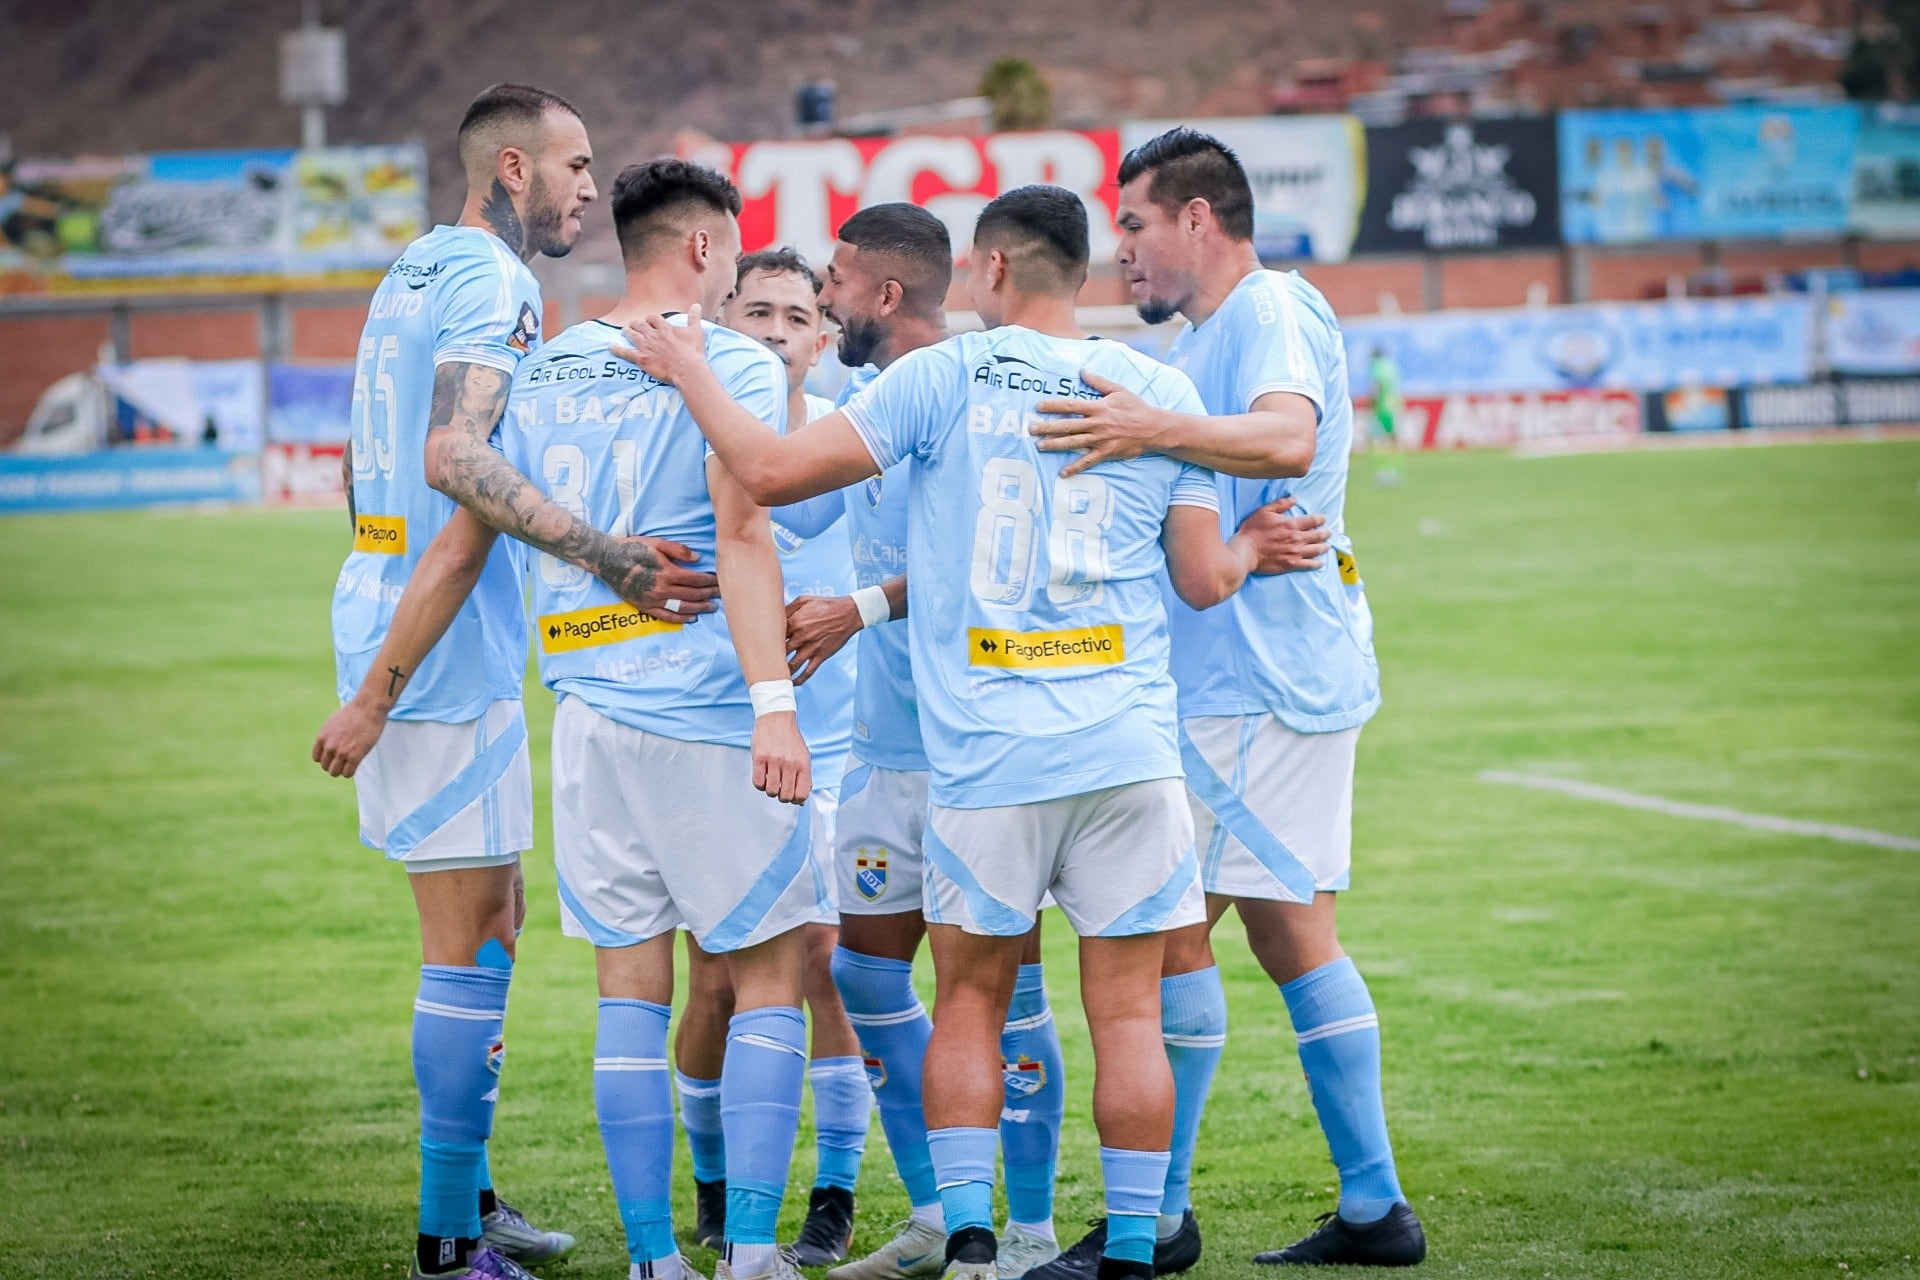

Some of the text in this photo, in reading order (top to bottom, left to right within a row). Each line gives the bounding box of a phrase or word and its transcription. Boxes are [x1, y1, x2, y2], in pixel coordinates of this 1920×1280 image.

[556, 365, 597, 381] COOL
[601, 361, 664, 384] SYSTE
[974, 365, 1003, 389] AIR
[1007, 372, 1053, 395] COOL
[352, 334, 399, 481] 55
[519, 390, 683, 427] N. BAZAN
[970, 457, 1116, 612] 88
[1004, 637, 1112, 660] PagoEfectivo
[860, 868, 882, 890] ADT
